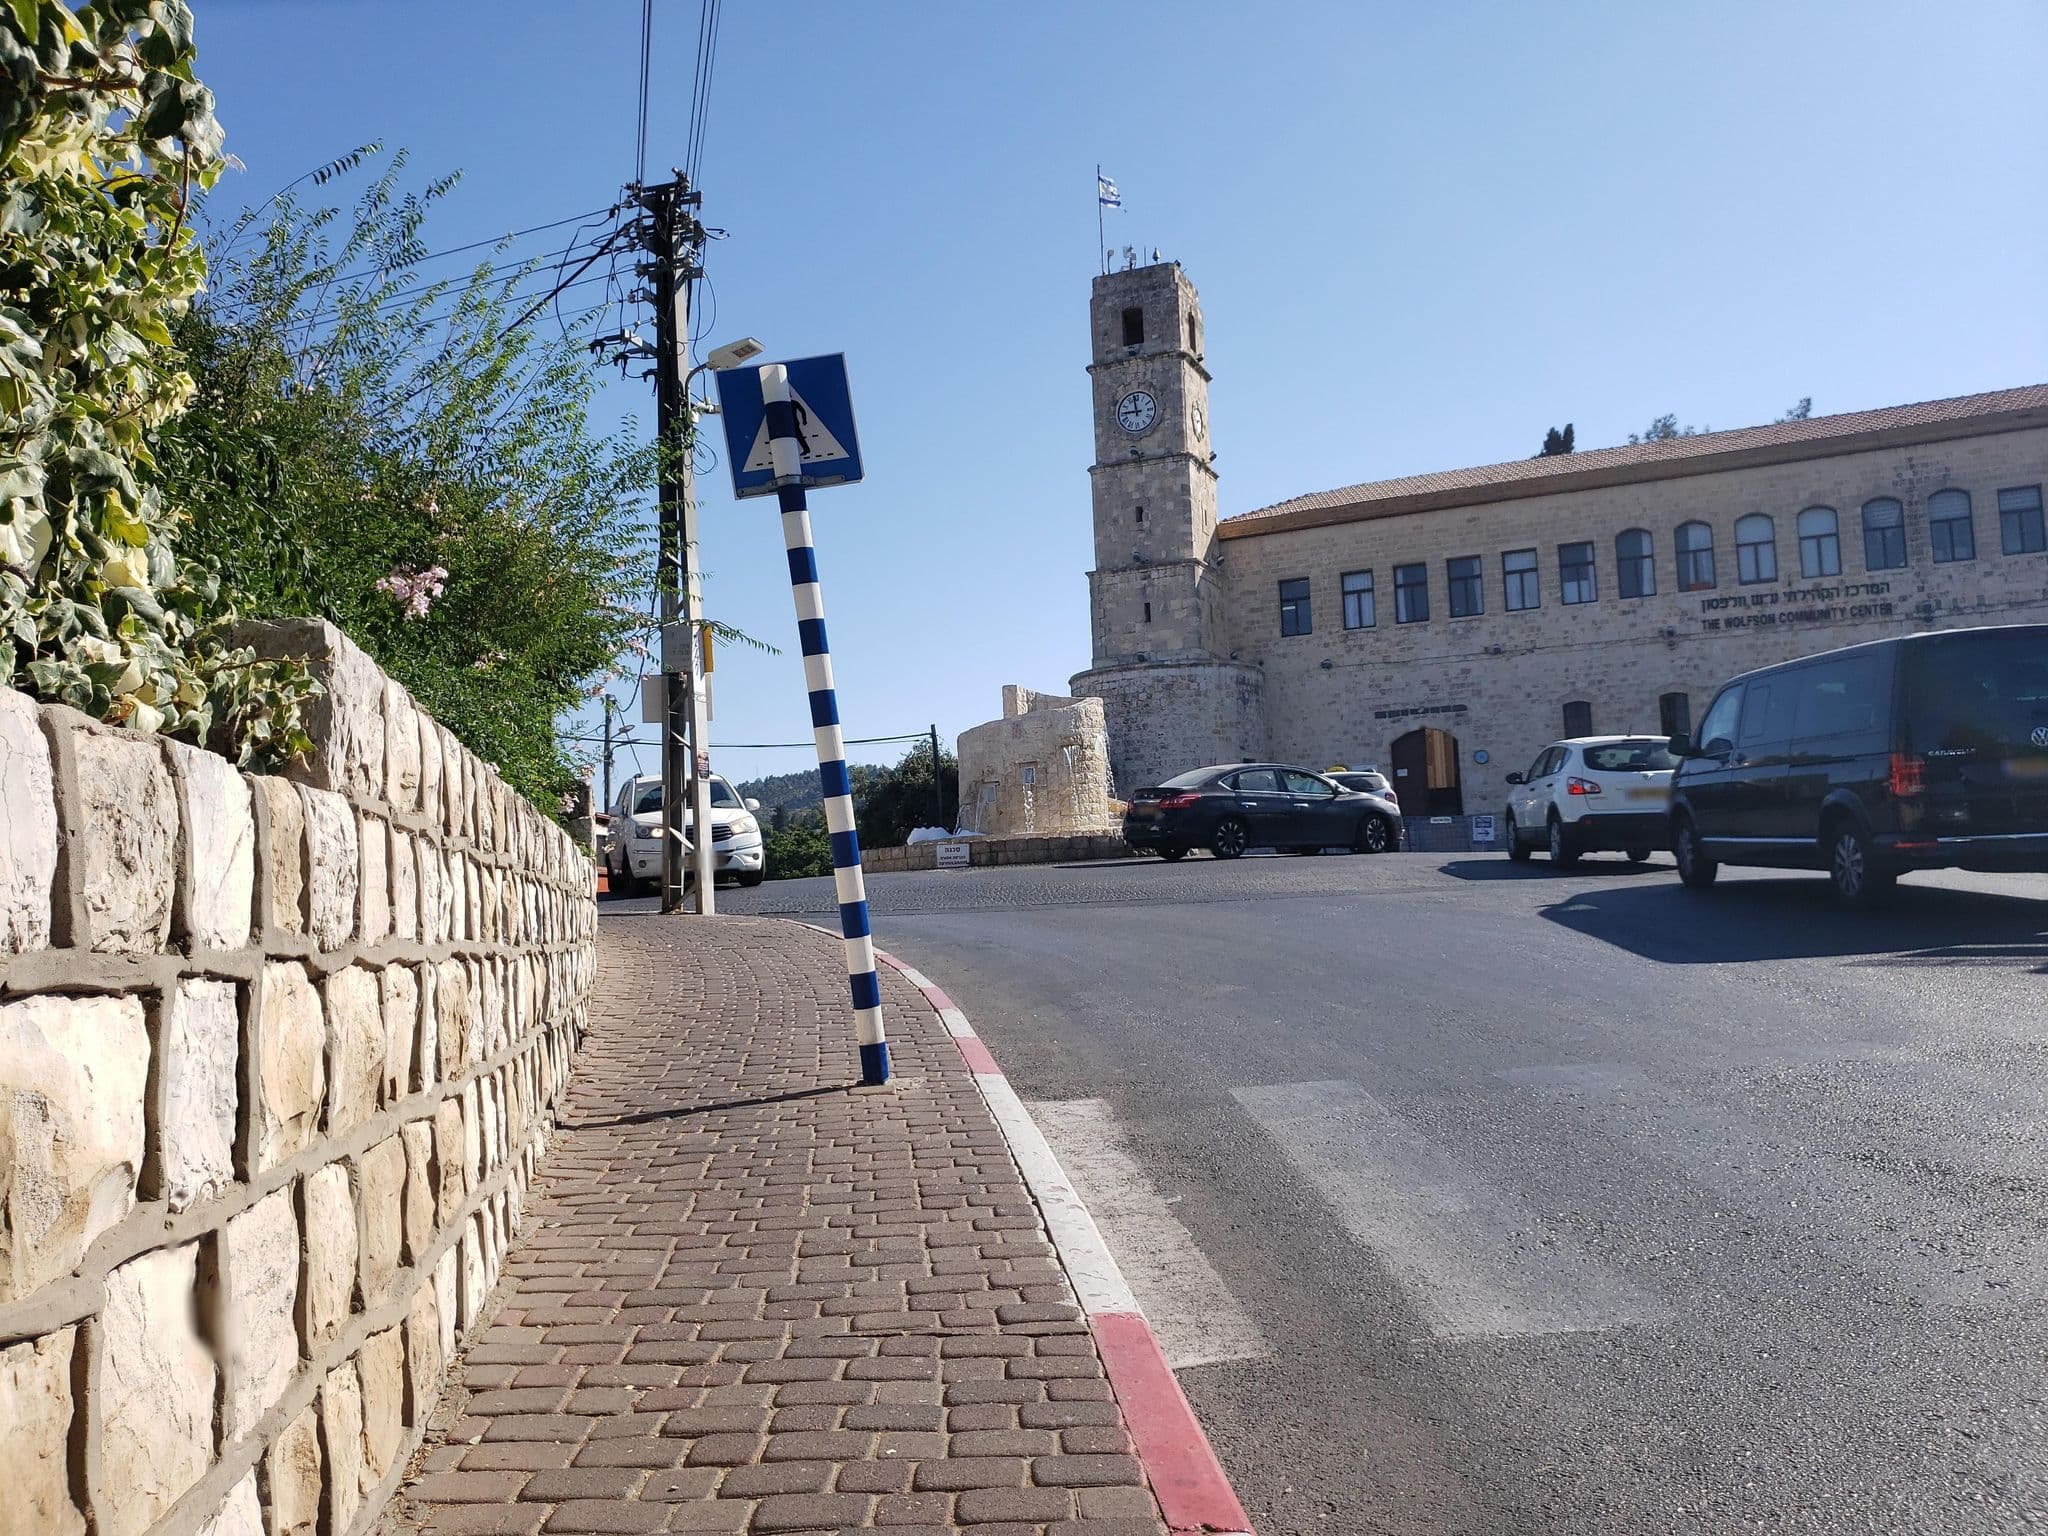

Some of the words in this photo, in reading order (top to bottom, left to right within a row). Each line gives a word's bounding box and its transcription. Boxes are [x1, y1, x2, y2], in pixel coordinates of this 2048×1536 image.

[1702, 618, 1721, 630] THE
[1724, 614, 1776, 629] WOLFSON
[1779, 606, 1847, 623] COMMUNITY
[1850, 603, 1893, 617] CENTER
